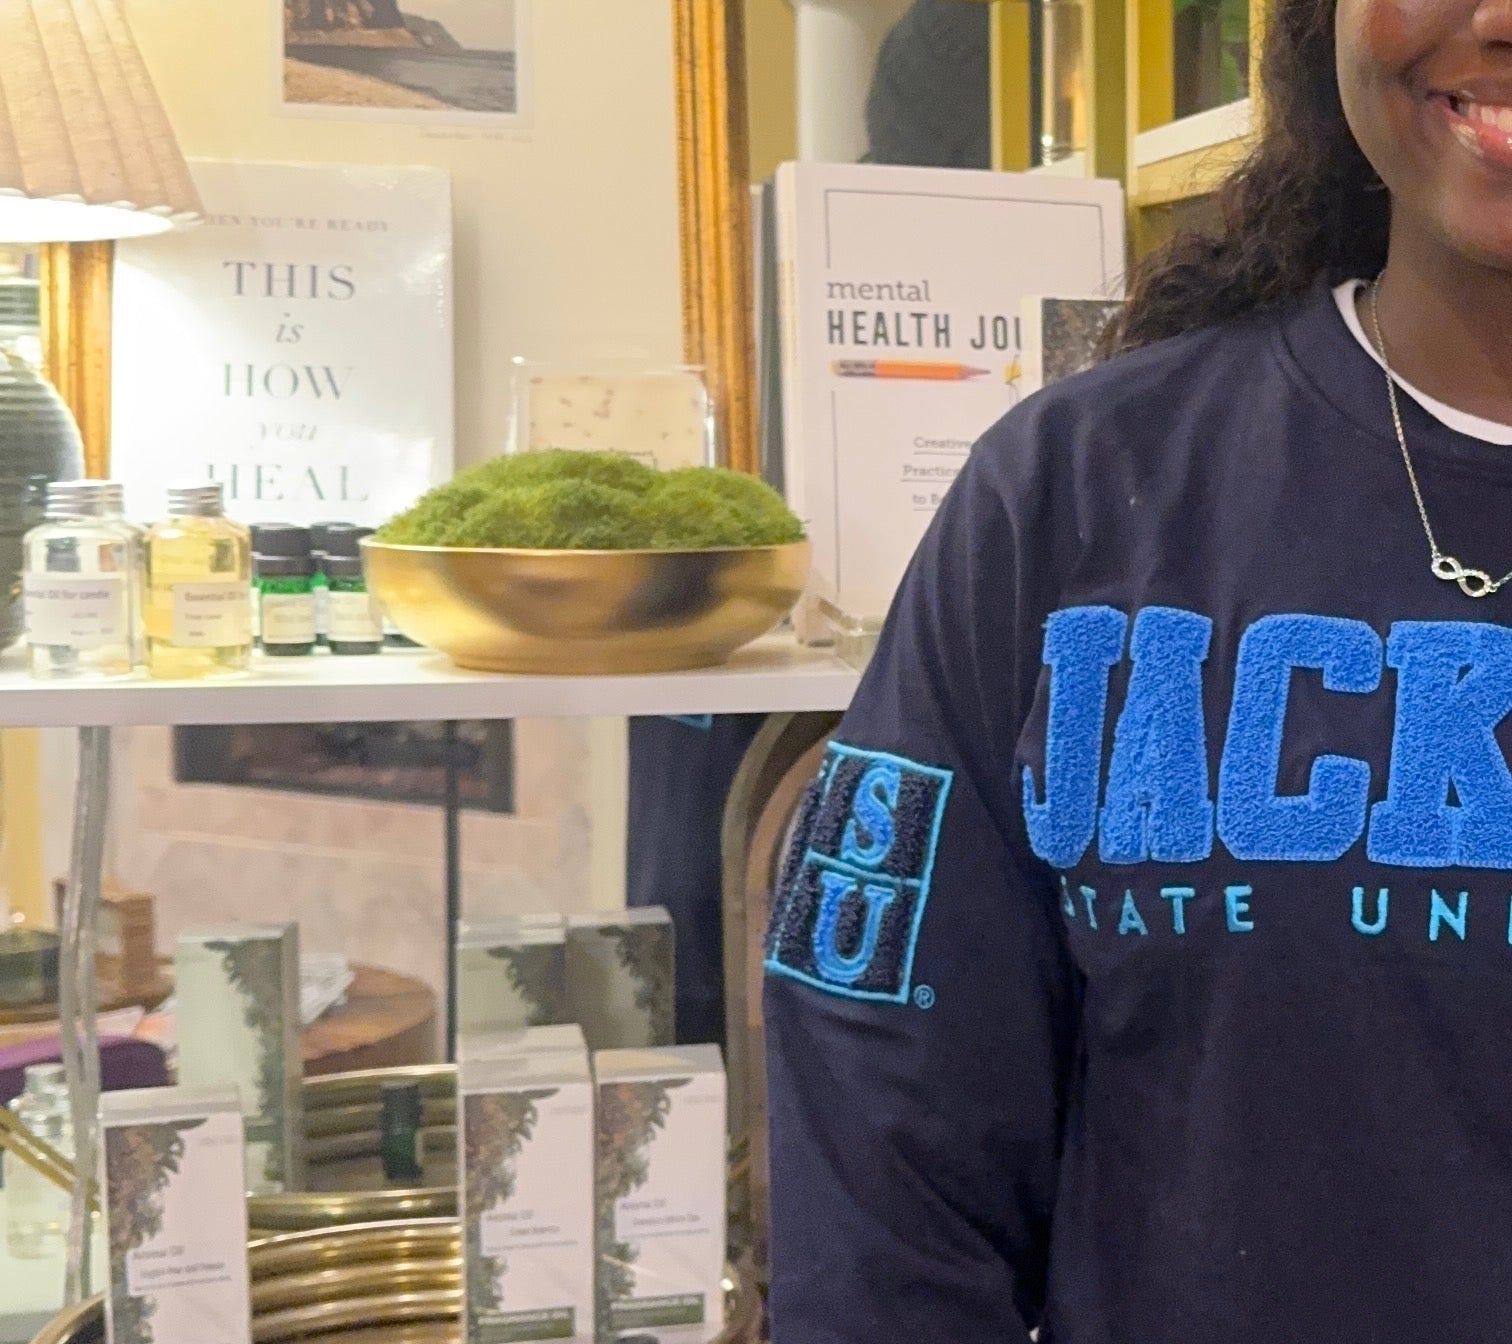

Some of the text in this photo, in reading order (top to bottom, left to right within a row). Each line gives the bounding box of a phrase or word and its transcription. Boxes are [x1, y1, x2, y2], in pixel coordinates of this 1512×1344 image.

[222, 260, 356, 301] THIS
[826, 279, 931, 303] mental
[275, 312, 304, 344] is
[828, 310, 951, 348] HEALTH
[223, 362, 356, 401] HOW
[206, 462, 370, 503] HEAL
[841, 765, 901, 866] S
[813, 871, 896, 984] U
